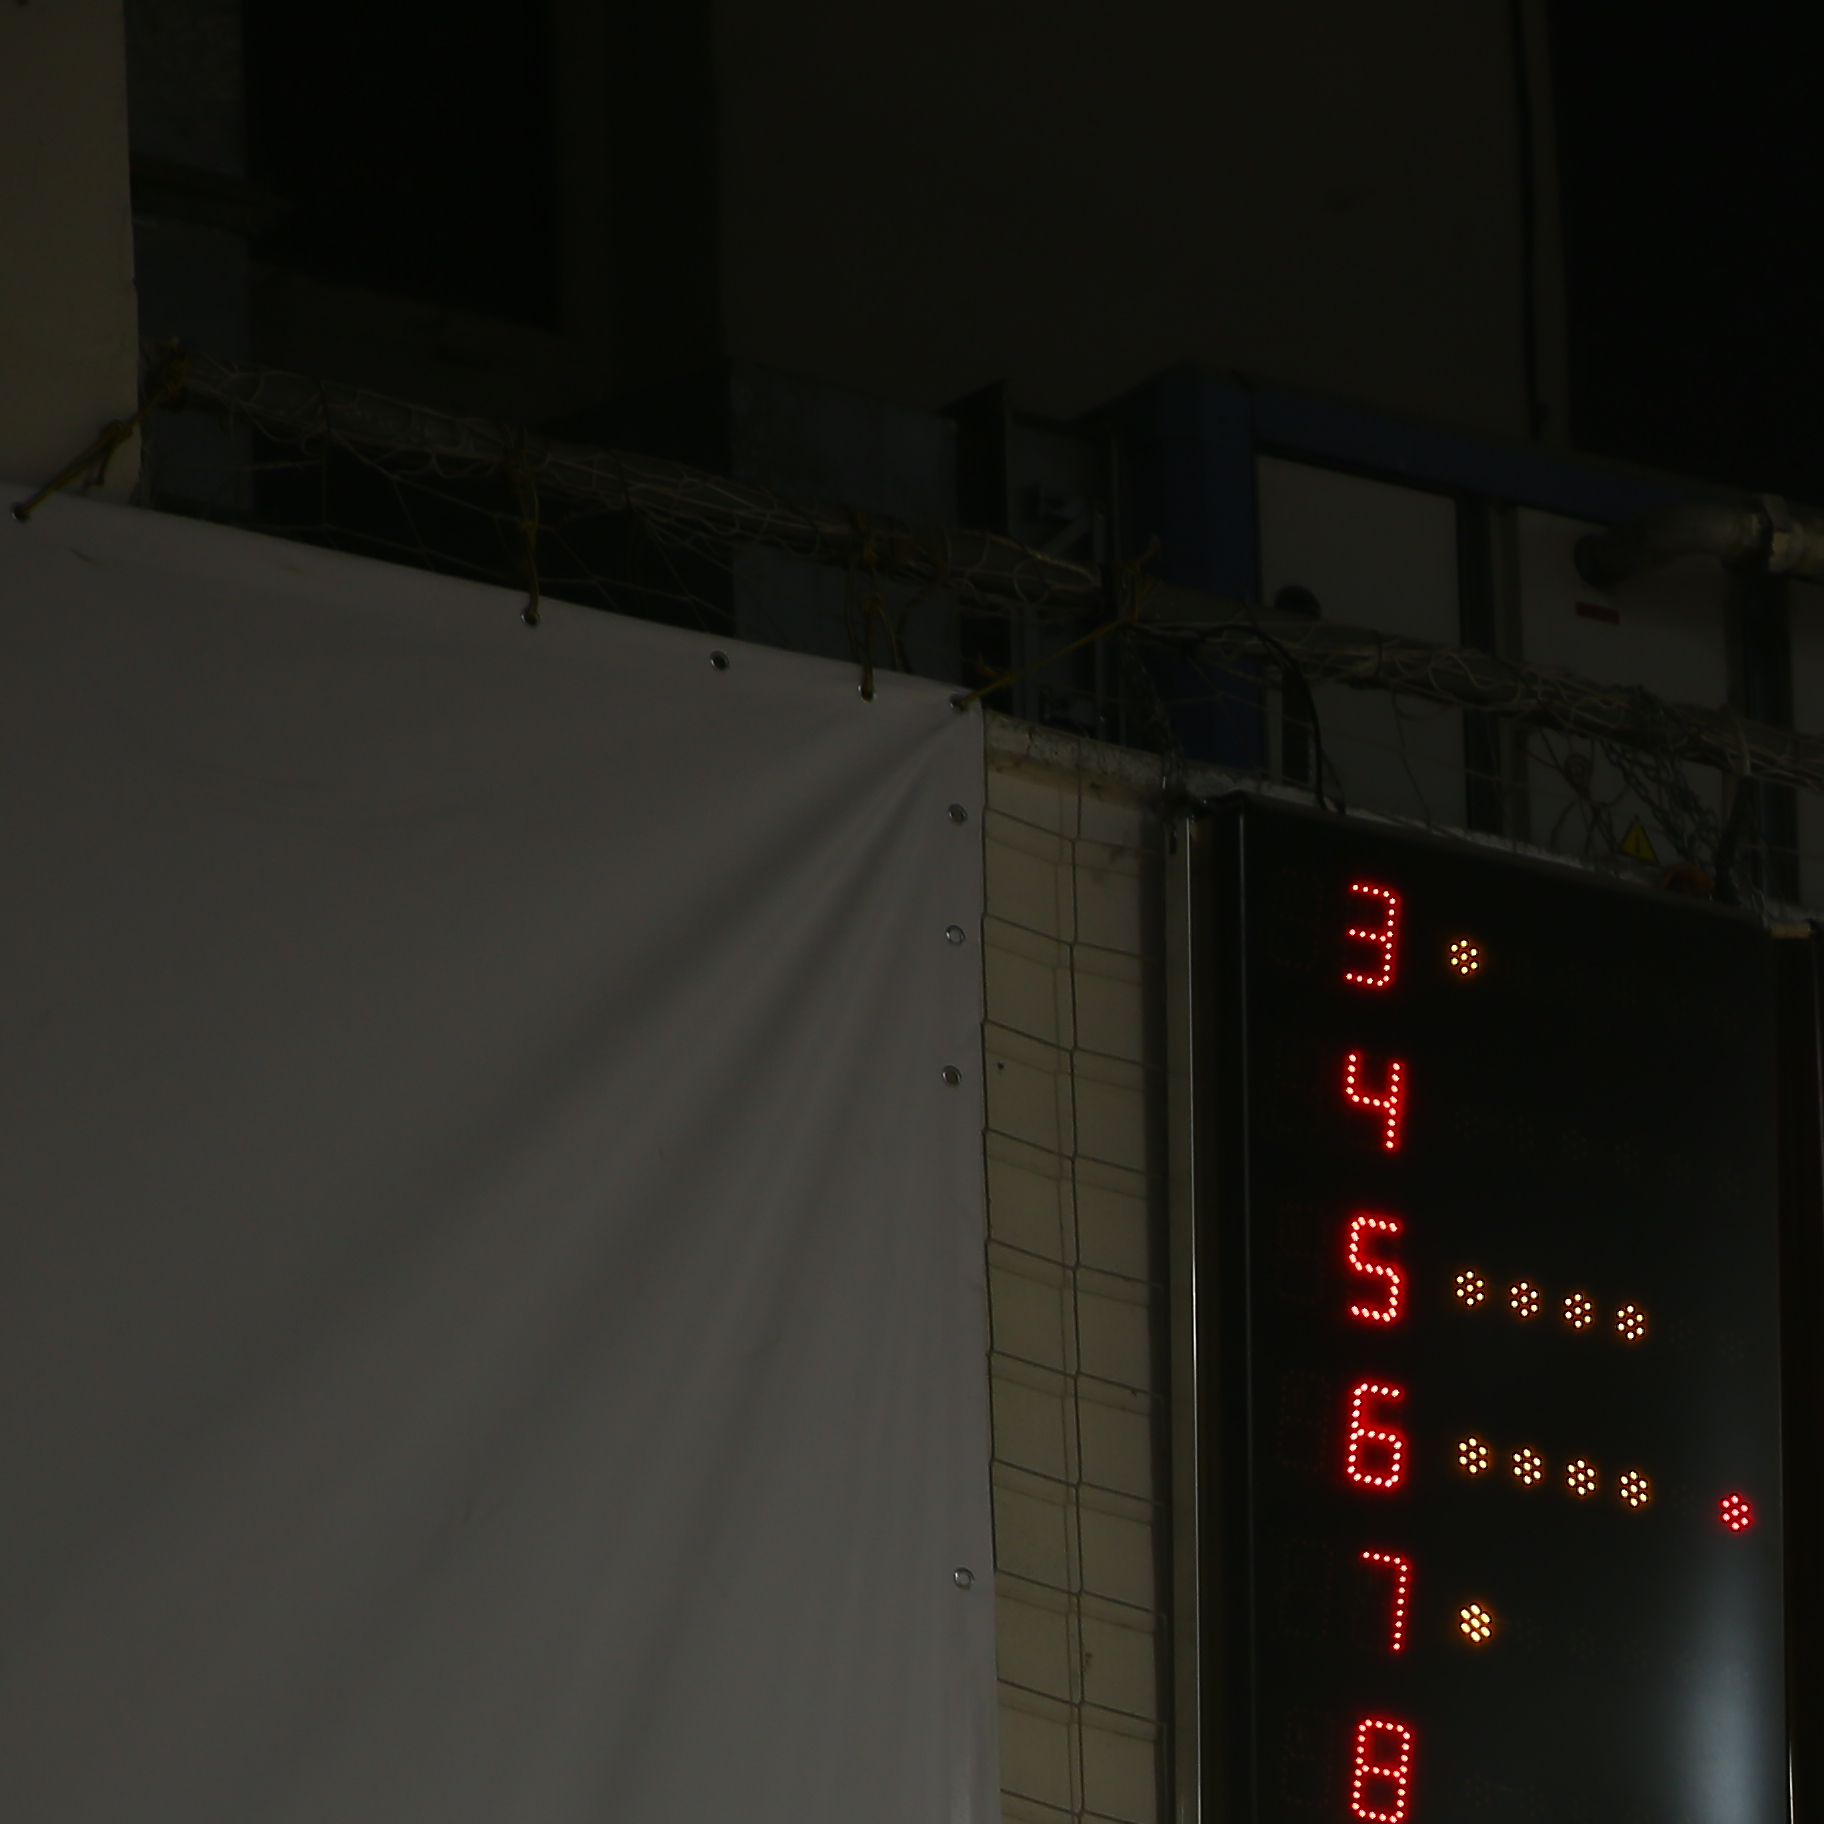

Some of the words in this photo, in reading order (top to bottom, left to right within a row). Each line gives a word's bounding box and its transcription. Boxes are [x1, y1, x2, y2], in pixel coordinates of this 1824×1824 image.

[1343, 882, 1401, 988] 3
[1342, 1051, 1405, 1151] 4
[1344, 1212, 1406, 1324] 5
[1344, 1380, 1407, 1490] 6
[1360, 1548, 1412, 1652] 7
